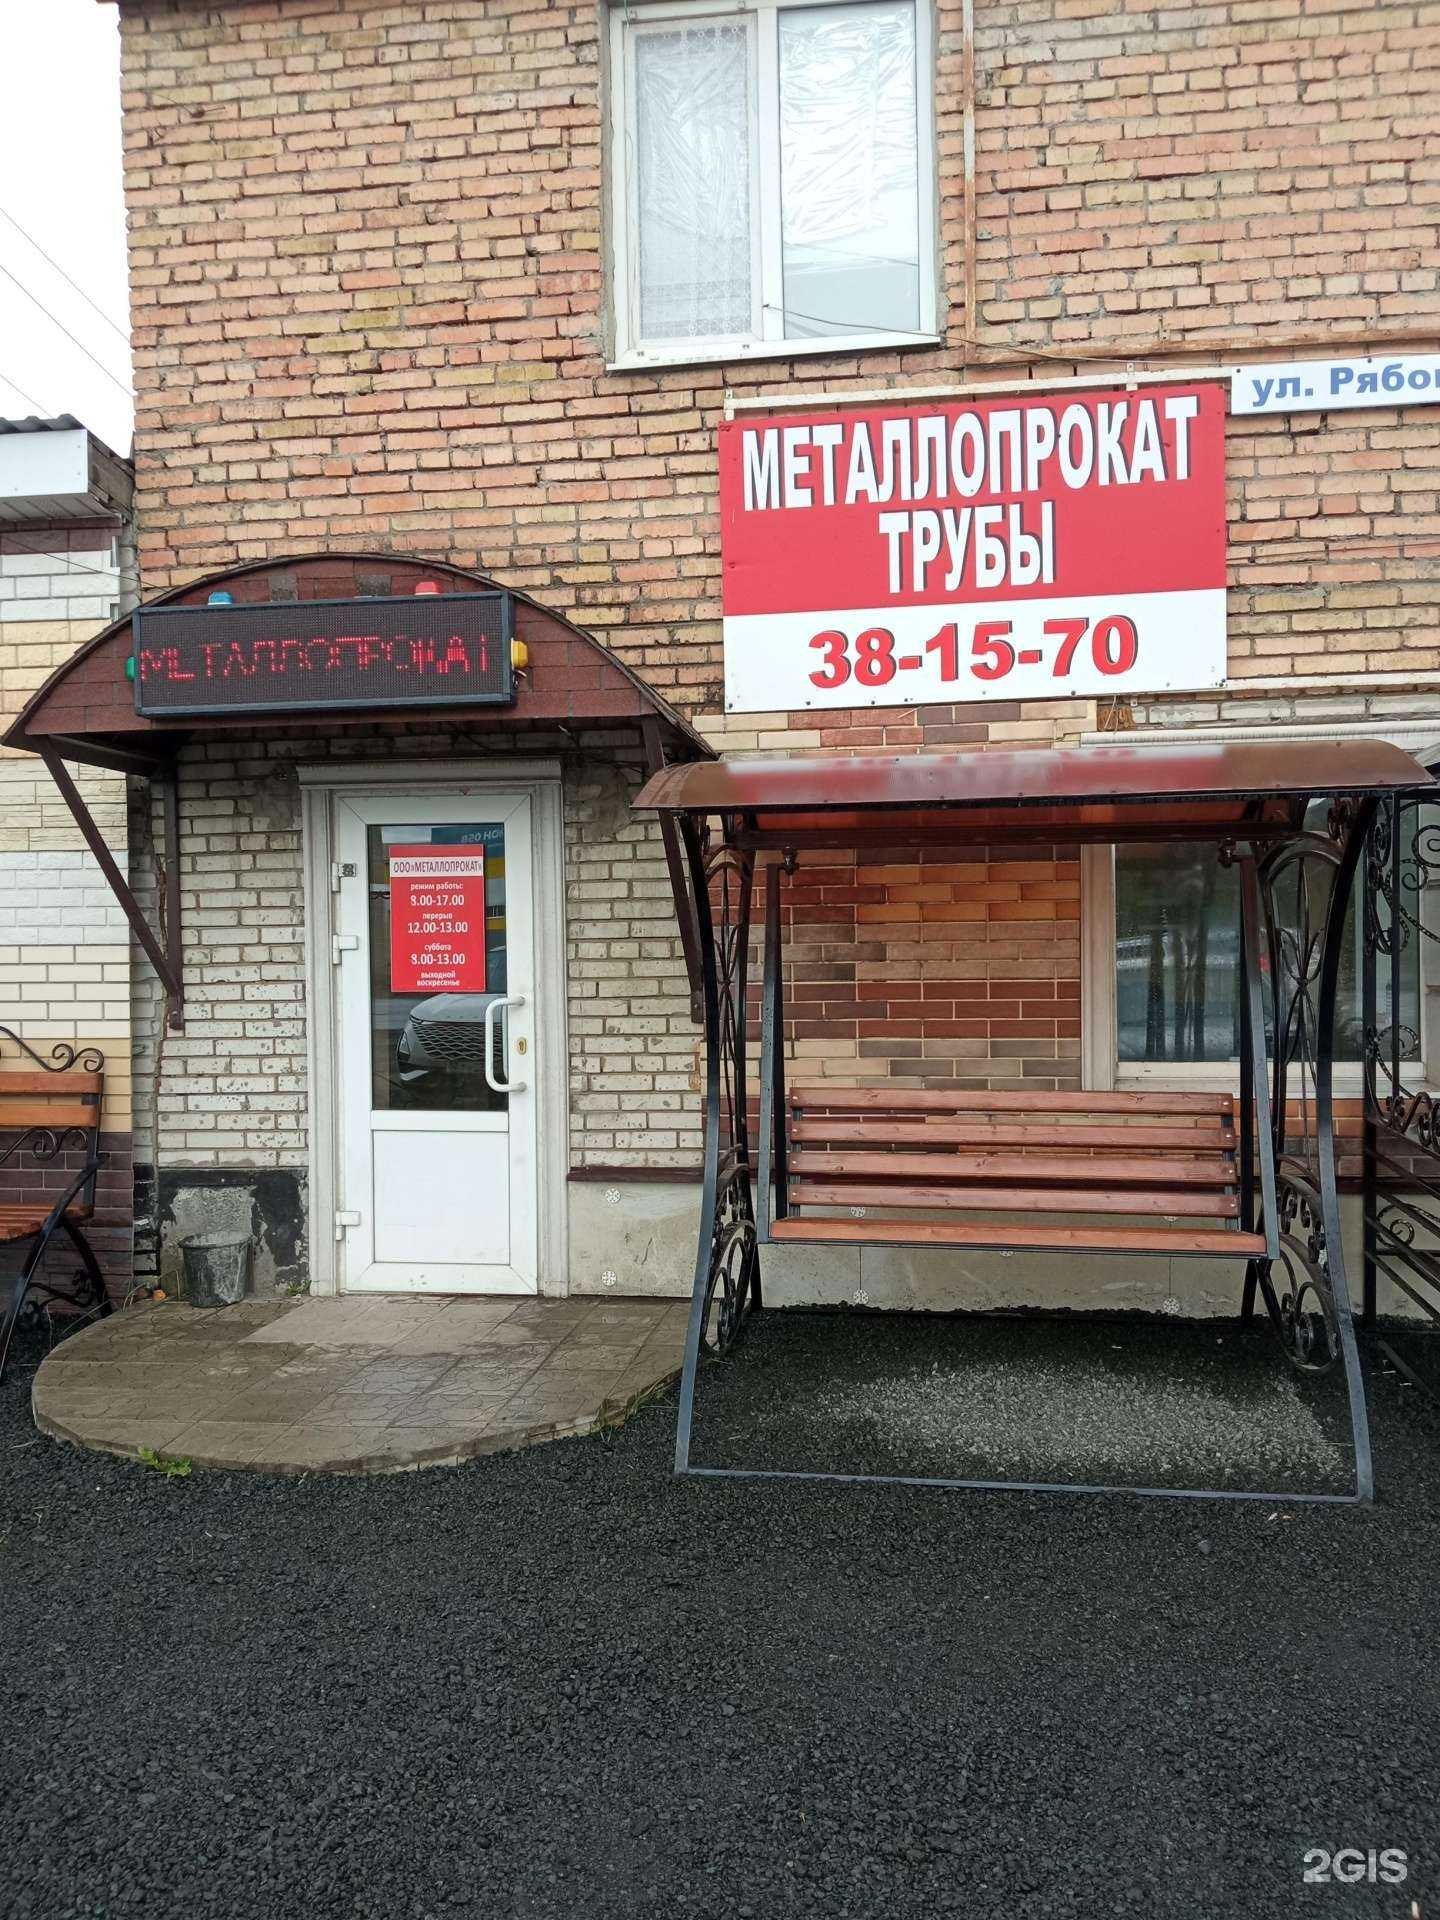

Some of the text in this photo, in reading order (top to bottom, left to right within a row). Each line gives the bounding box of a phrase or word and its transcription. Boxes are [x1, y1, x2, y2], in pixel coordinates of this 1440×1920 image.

[1251, 363, 1440, 407] ул. Рябо
[741, 395, 1199, 512] МЕТАЛЛОПРОКАТ
[878, 501, 1057, 594] ТРУБЫ
[808, 614, 1139, 689] 38-15-70
[410, 883, 435, 891] режим
[410, 894, 465, 906] 8.00-17.00
[422, 912, 453, 921] перерыв
[407, 922, 468, 934] 12.00-13.00
[424, 942, 452, 952] суббота
[410, 953, 466, 965] 8.00-13.00
[420, 970, 456, 979] выходной
